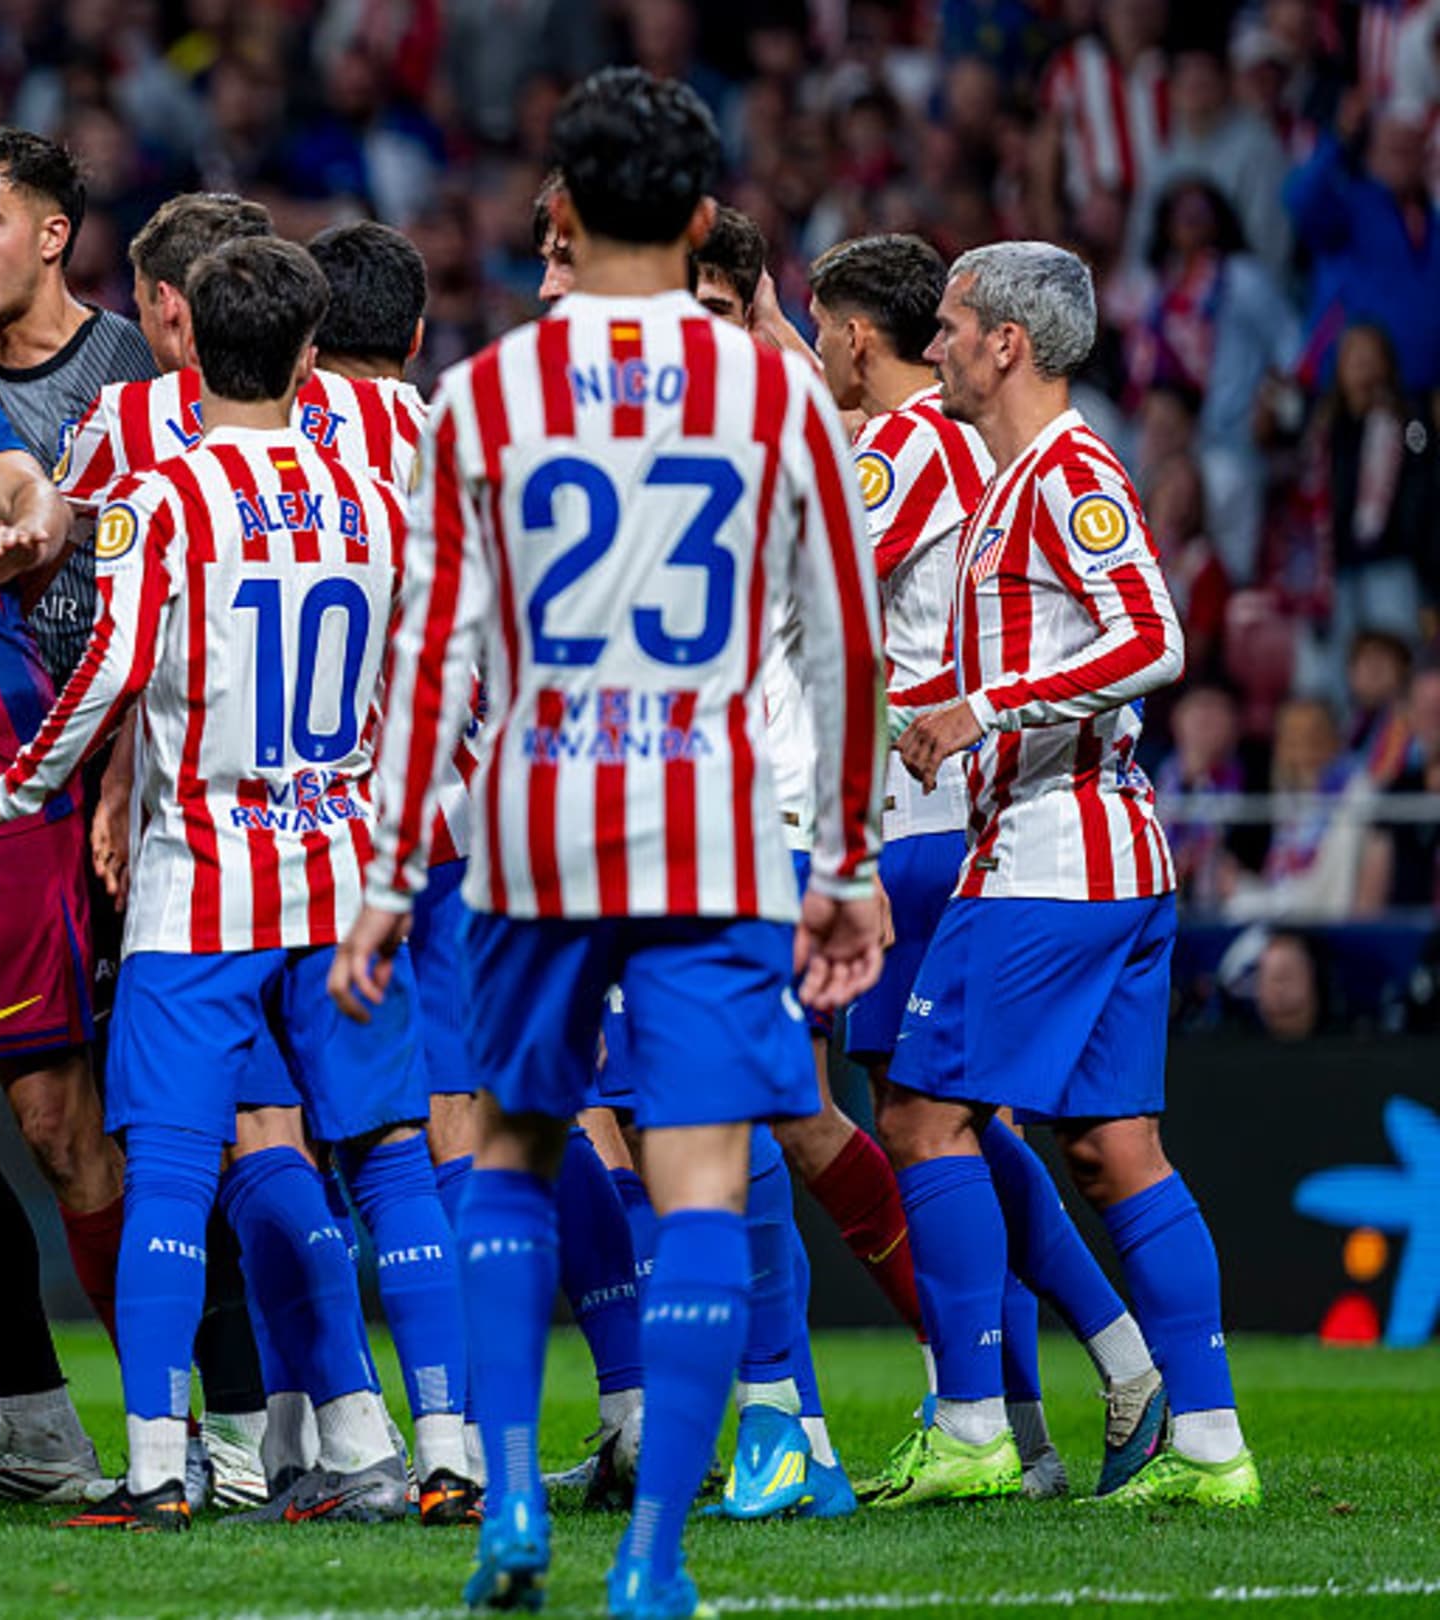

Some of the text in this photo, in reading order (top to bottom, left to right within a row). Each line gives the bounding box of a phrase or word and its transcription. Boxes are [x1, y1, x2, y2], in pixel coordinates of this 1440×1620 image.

[569, 358, 689, 405] NICO
[522, 455, 745, 666] 23
[232, 577, 370, 768] 10
[565, 693, 673, 724] VISIT
[522, 729, 711, 759] RWANDA
